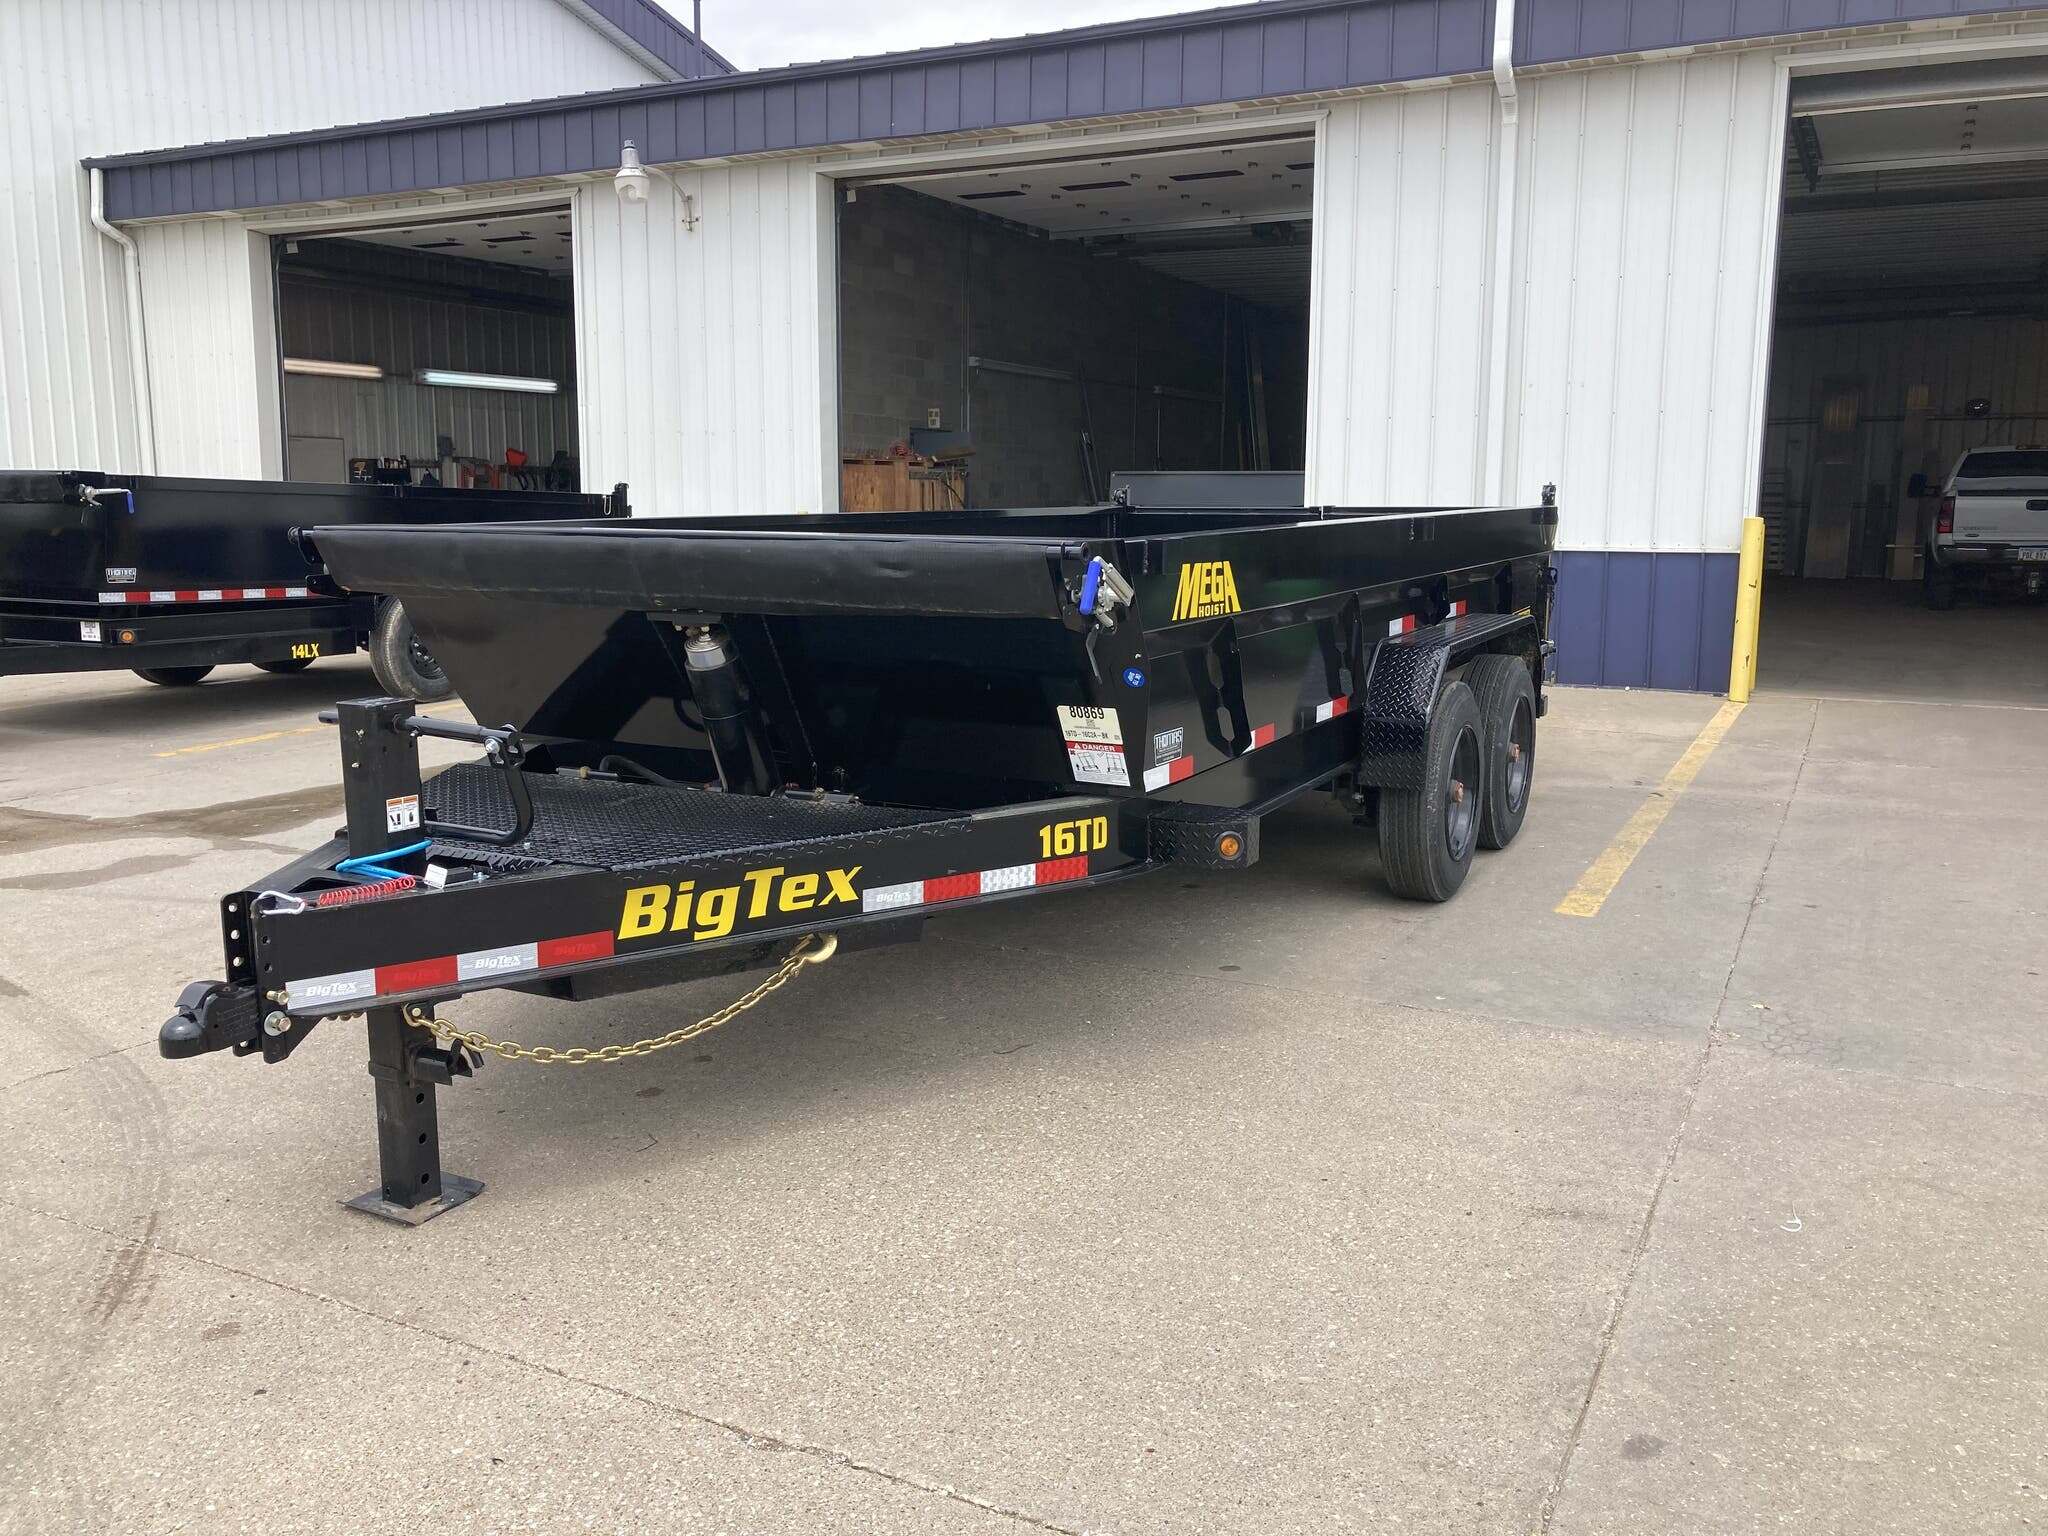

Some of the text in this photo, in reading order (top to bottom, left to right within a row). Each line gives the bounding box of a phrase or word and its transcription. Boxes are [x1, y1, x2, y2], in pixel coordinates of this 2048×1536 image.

[1172, 561, 1241, 621] MEGA
[1198, 603, 1225, 618] HOIST
[291, 643, 320, 659] 14LX
[1069, 706, 1105, 719] 80869
[1082, 743, 1116, 752] DANGER
[1155, 730, 1182, 750] THOMAS
[1039, 816, 1108, 858] 16TD
[617, 865, 863, 941] BigTex
